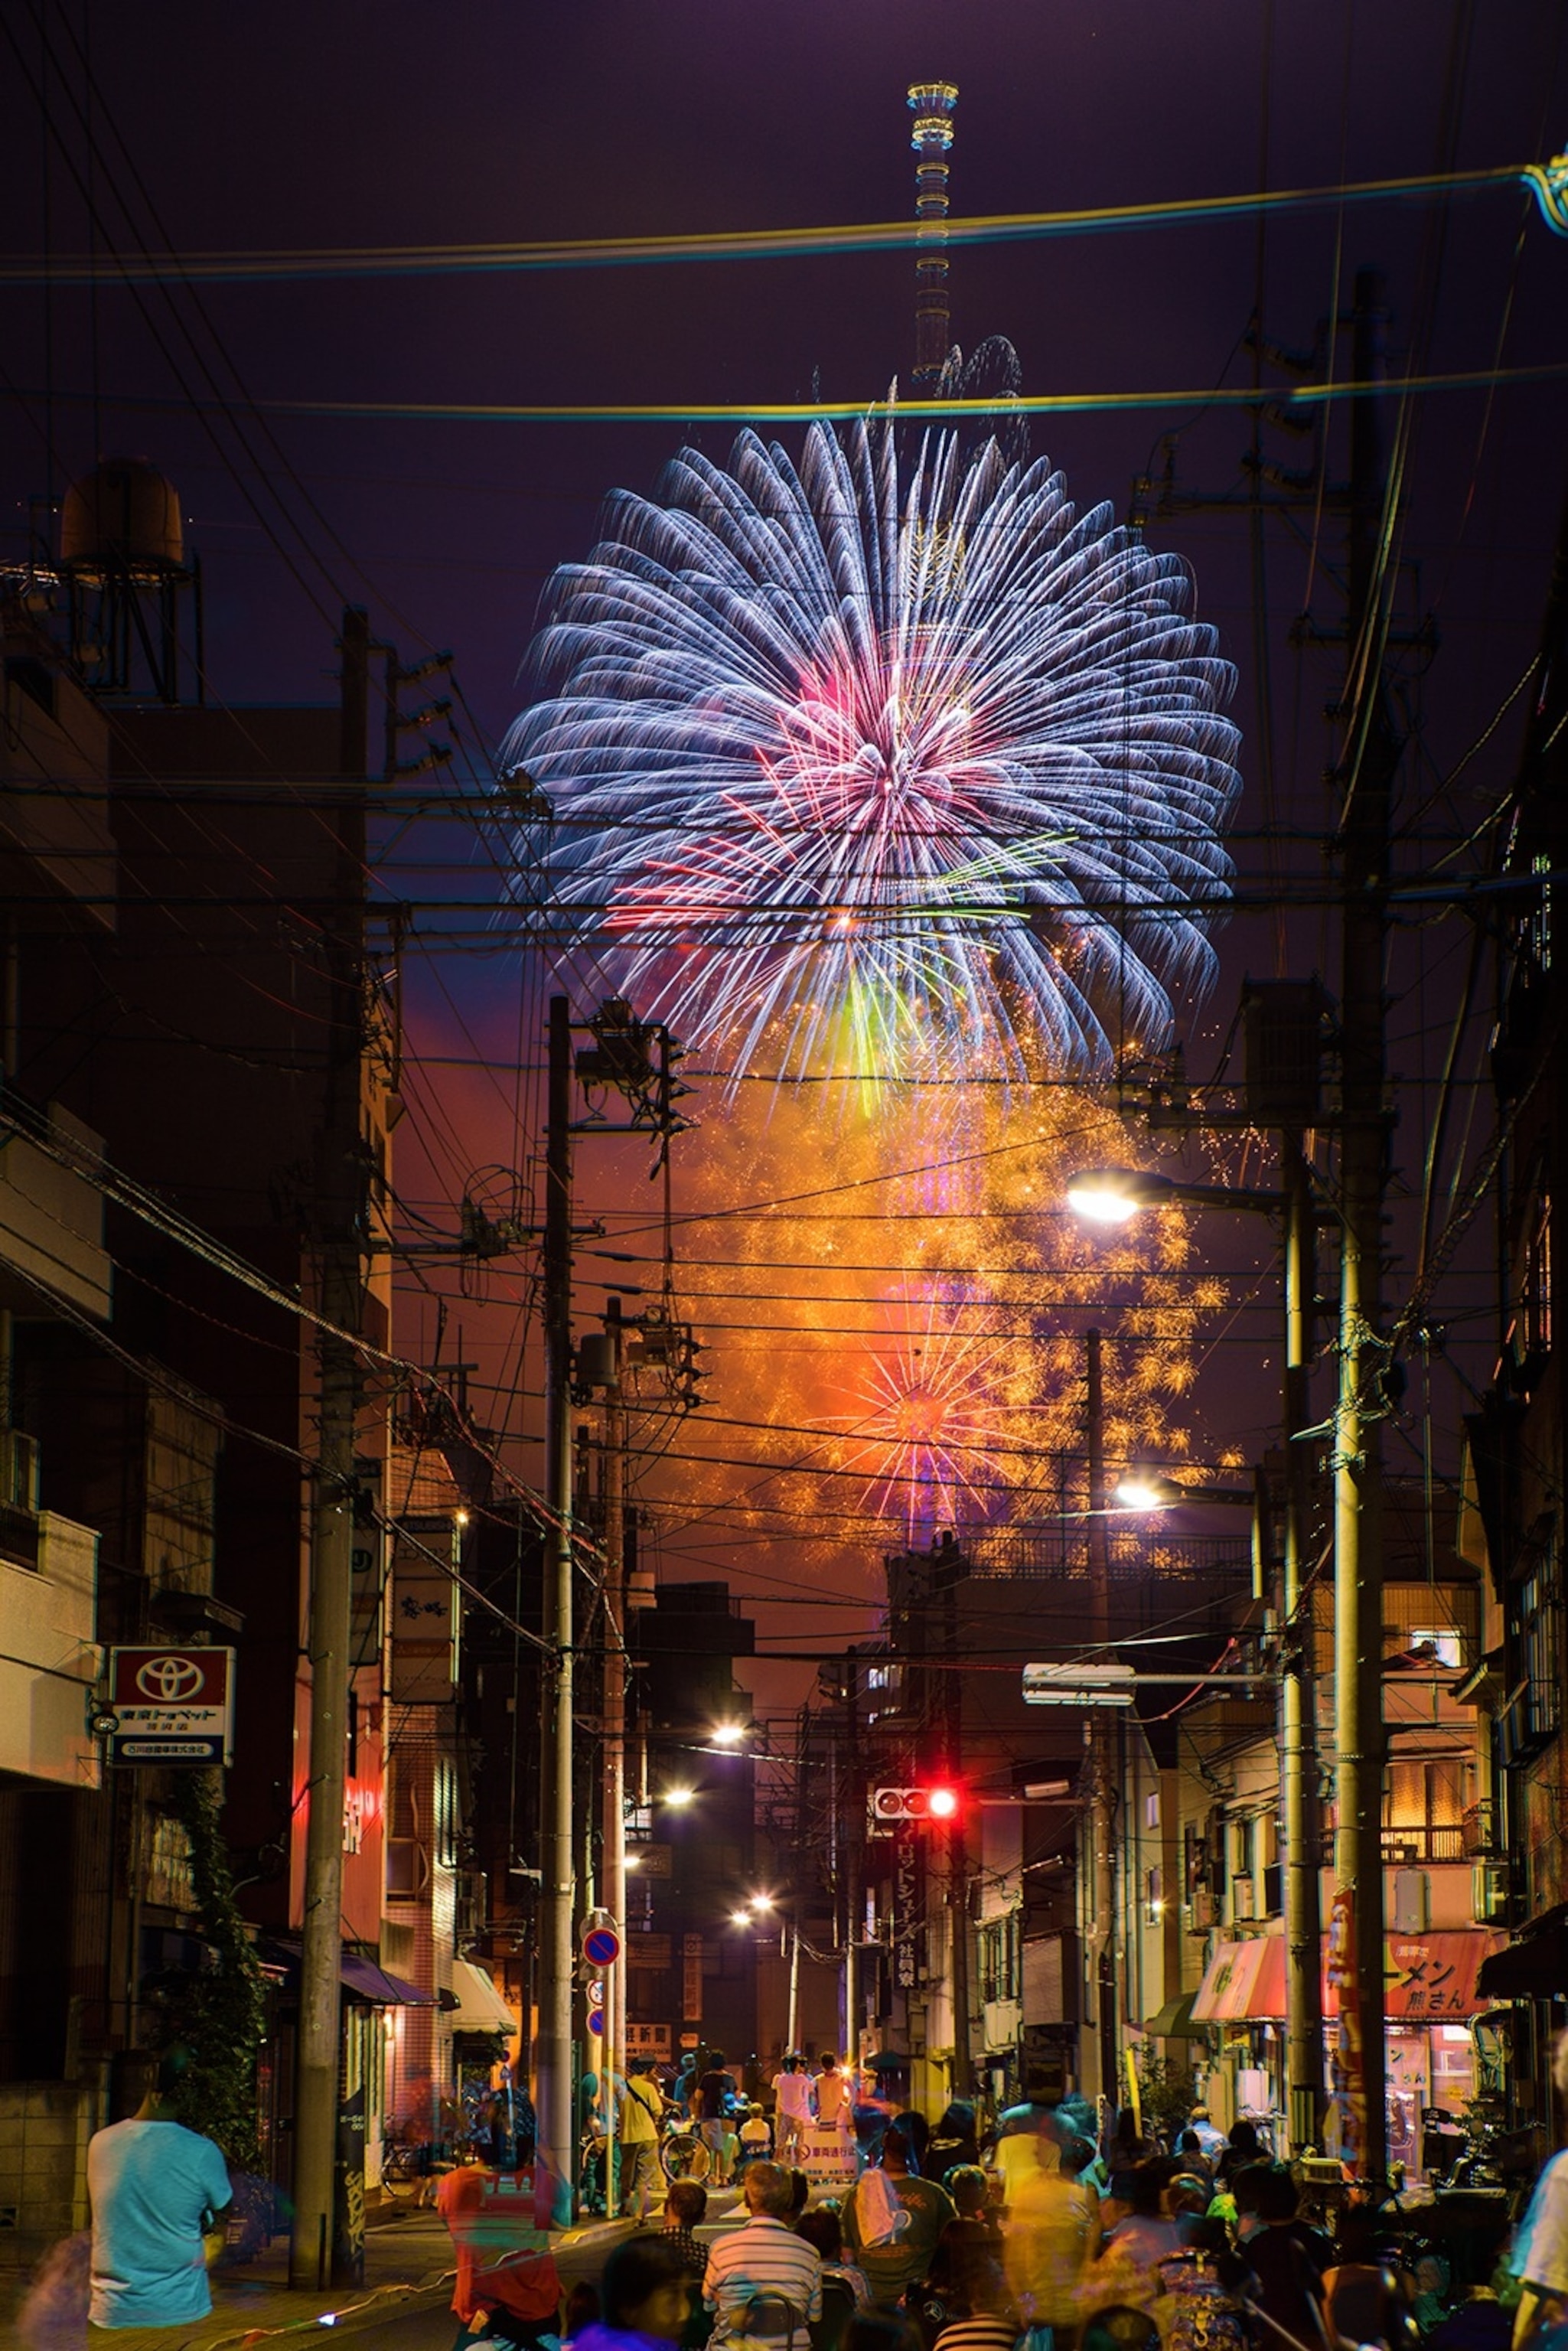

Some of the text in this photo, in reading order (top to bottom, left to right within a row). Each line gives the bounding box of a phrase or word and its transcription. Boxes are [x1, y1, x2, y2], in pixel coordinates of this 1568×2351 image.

[120, 1710, 216, 1720] 東京トヨペット
[1408, 1990, 1465, 2010] 熊さん
